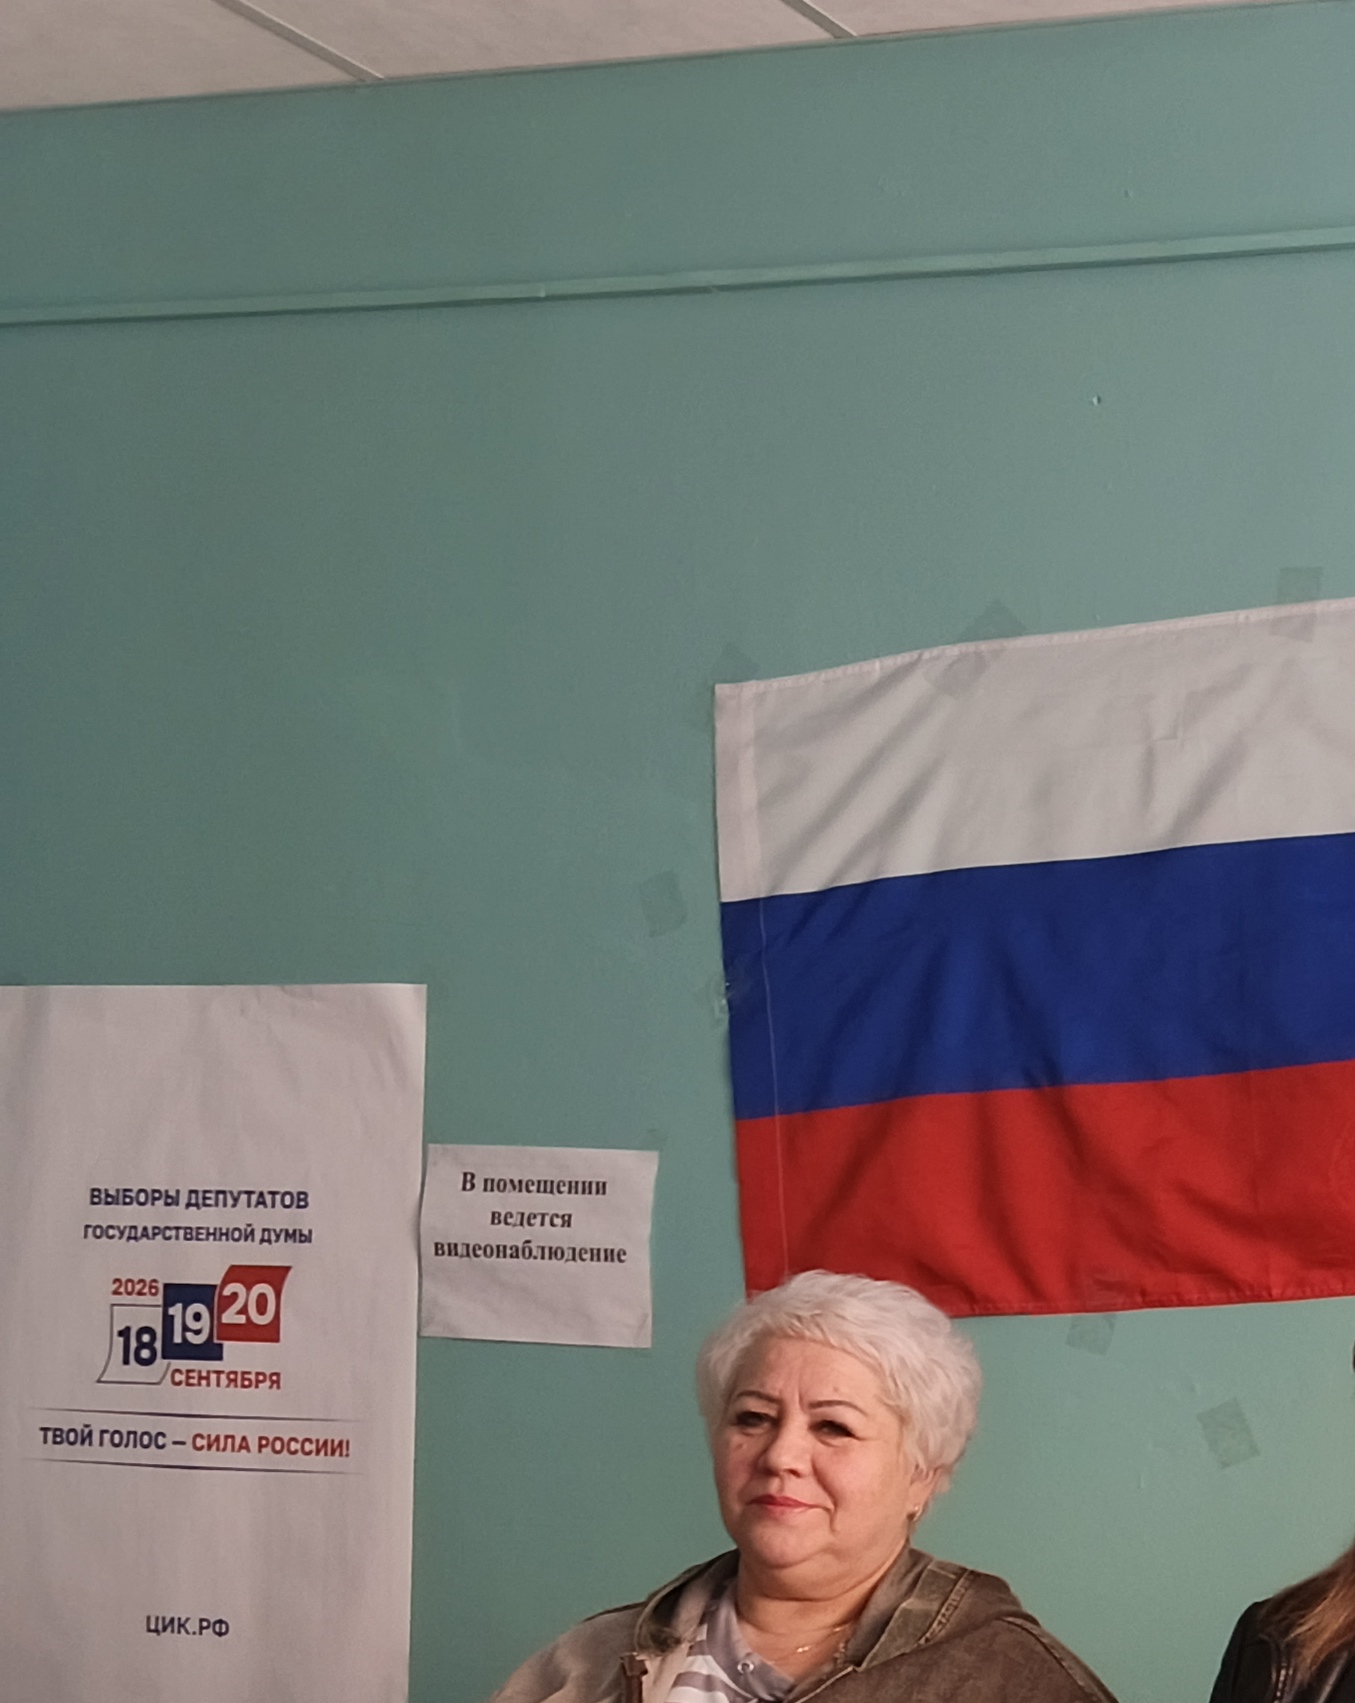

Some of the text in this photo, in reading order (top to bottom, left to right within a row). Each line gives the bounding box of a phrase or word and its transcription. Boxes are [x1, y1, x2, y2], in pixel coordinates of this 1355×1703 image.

[461, 1171, 607, 1196] В помещении
[89, 1188, 310, 1210] ВЫБОРЫ ДЕПУТАТОВ
[490, 1210, 572, 1229] ведется
[83, 1224, 313, 1245] ГОСУДАРСТВЕННОЙ ДУМЫ
[433, 1239, 627, 1263] видеонаблюдение
[111, 1278, 160, 1297] 2026
[117, 1282, 276, 1367] 18 19 20
[170, 1368, 281, 1390] СЕНТЯБРЯ
[39, 1424, 93, 1447] ТВОЙ
[98, 1429, 167, 1449] ГОЛОС
[191, 1433, 252, 1454] СИЛА
[257, 1436, 350, 1458] РОССИИ!
[145, 1615, 230, 1637] ЦИК.РФ
